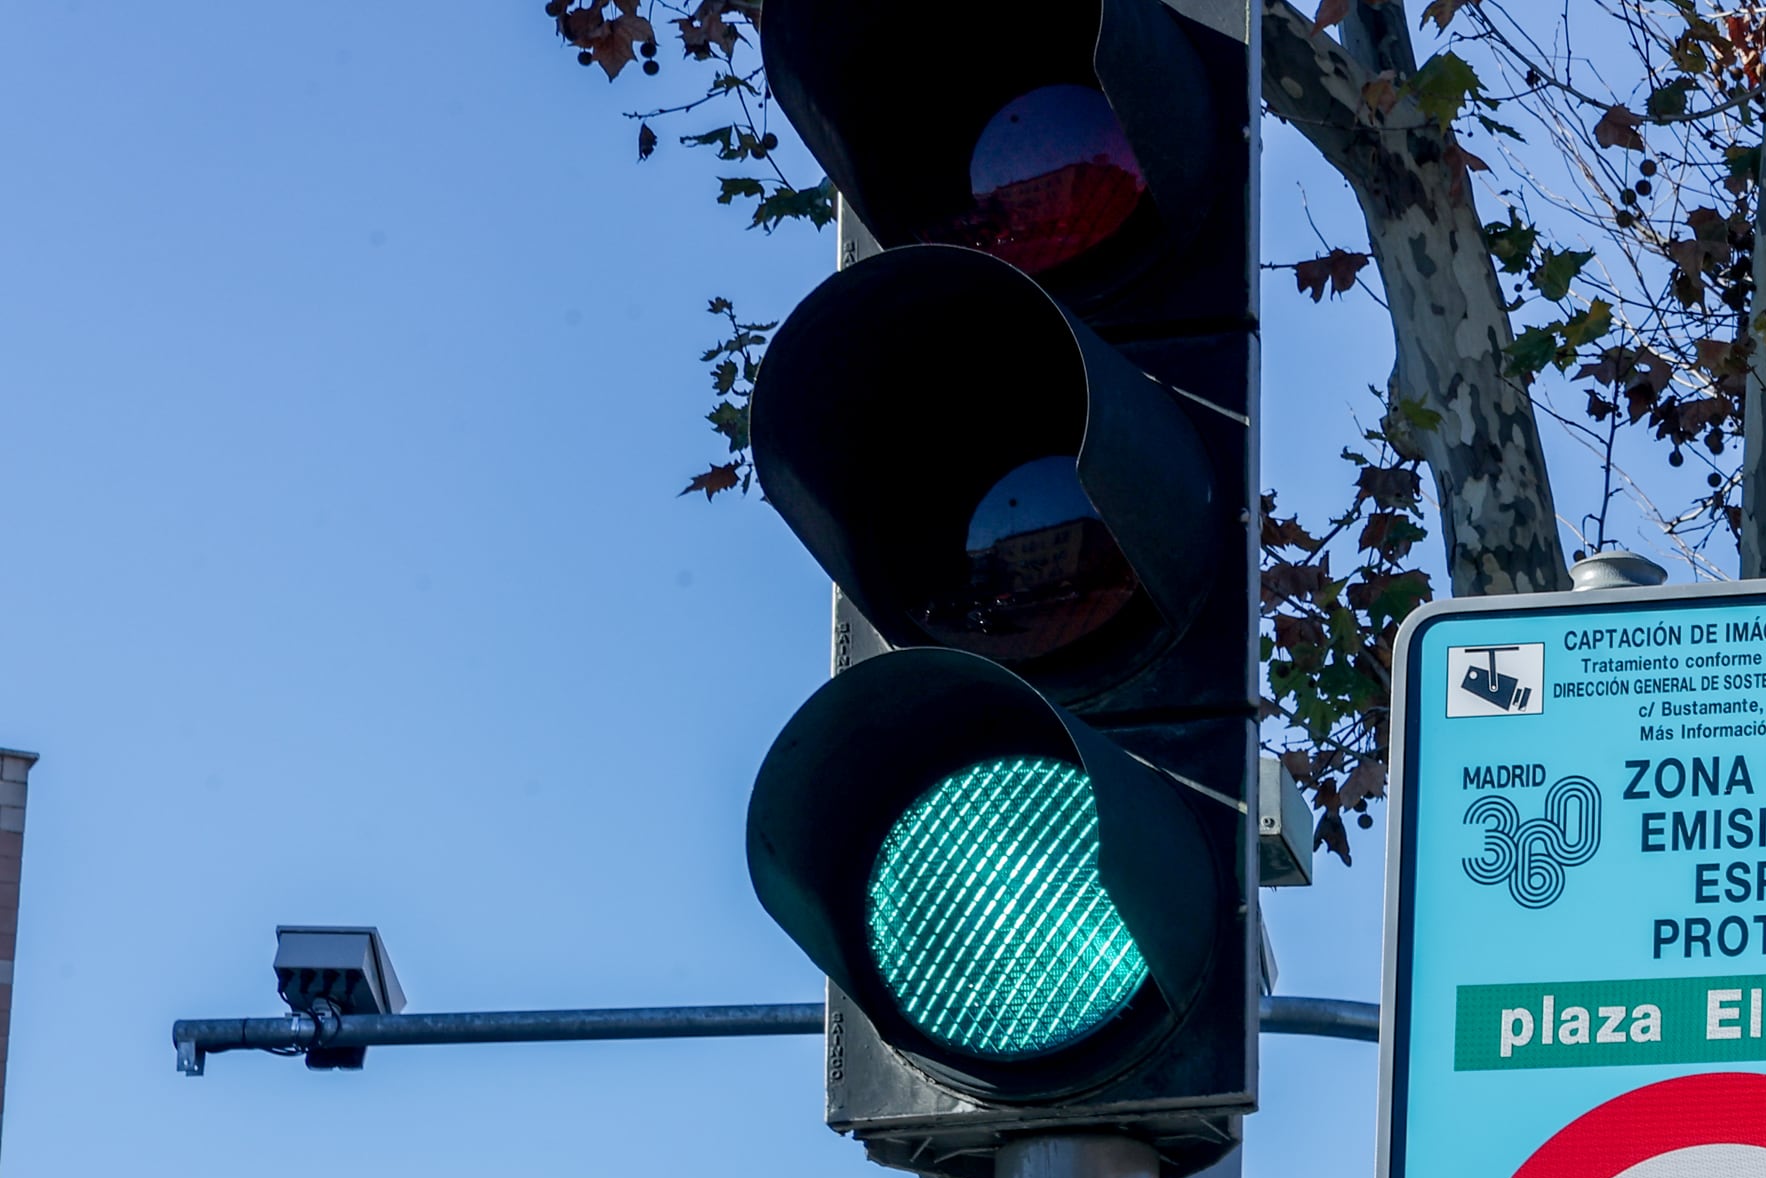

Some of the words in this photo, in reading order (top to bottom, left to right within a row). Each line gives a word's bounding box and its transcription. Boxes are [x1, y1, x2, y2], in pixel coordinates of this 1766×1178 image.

[1563, 620, 1682, 652] CAPTACIÓN
[1690, 623, 1718, 645] DE
[1580, 655, 1679, 674] Tratamiento
[1685, 651, 1763, 669] conforme
[1553, 675, 1630, 699] DIRECCIÓN
[1633, 676, 1697, 695] GENERAL
[1700, 674, 1720, 692] DE
[1638, 701, 1656, 718] c/
[1661, 698, 1764, 717] Bustamante,
[1640, 724, 1674, 742] Más
[1462, 763, 1547, 791] MADRID
[1622, 757, 1755, 801] ZONA
[1461, 774, 1603, 910] 360
[1500, 995, 1662, 1058] plaza
[830, 1010, 844, 1082] SAINCO
